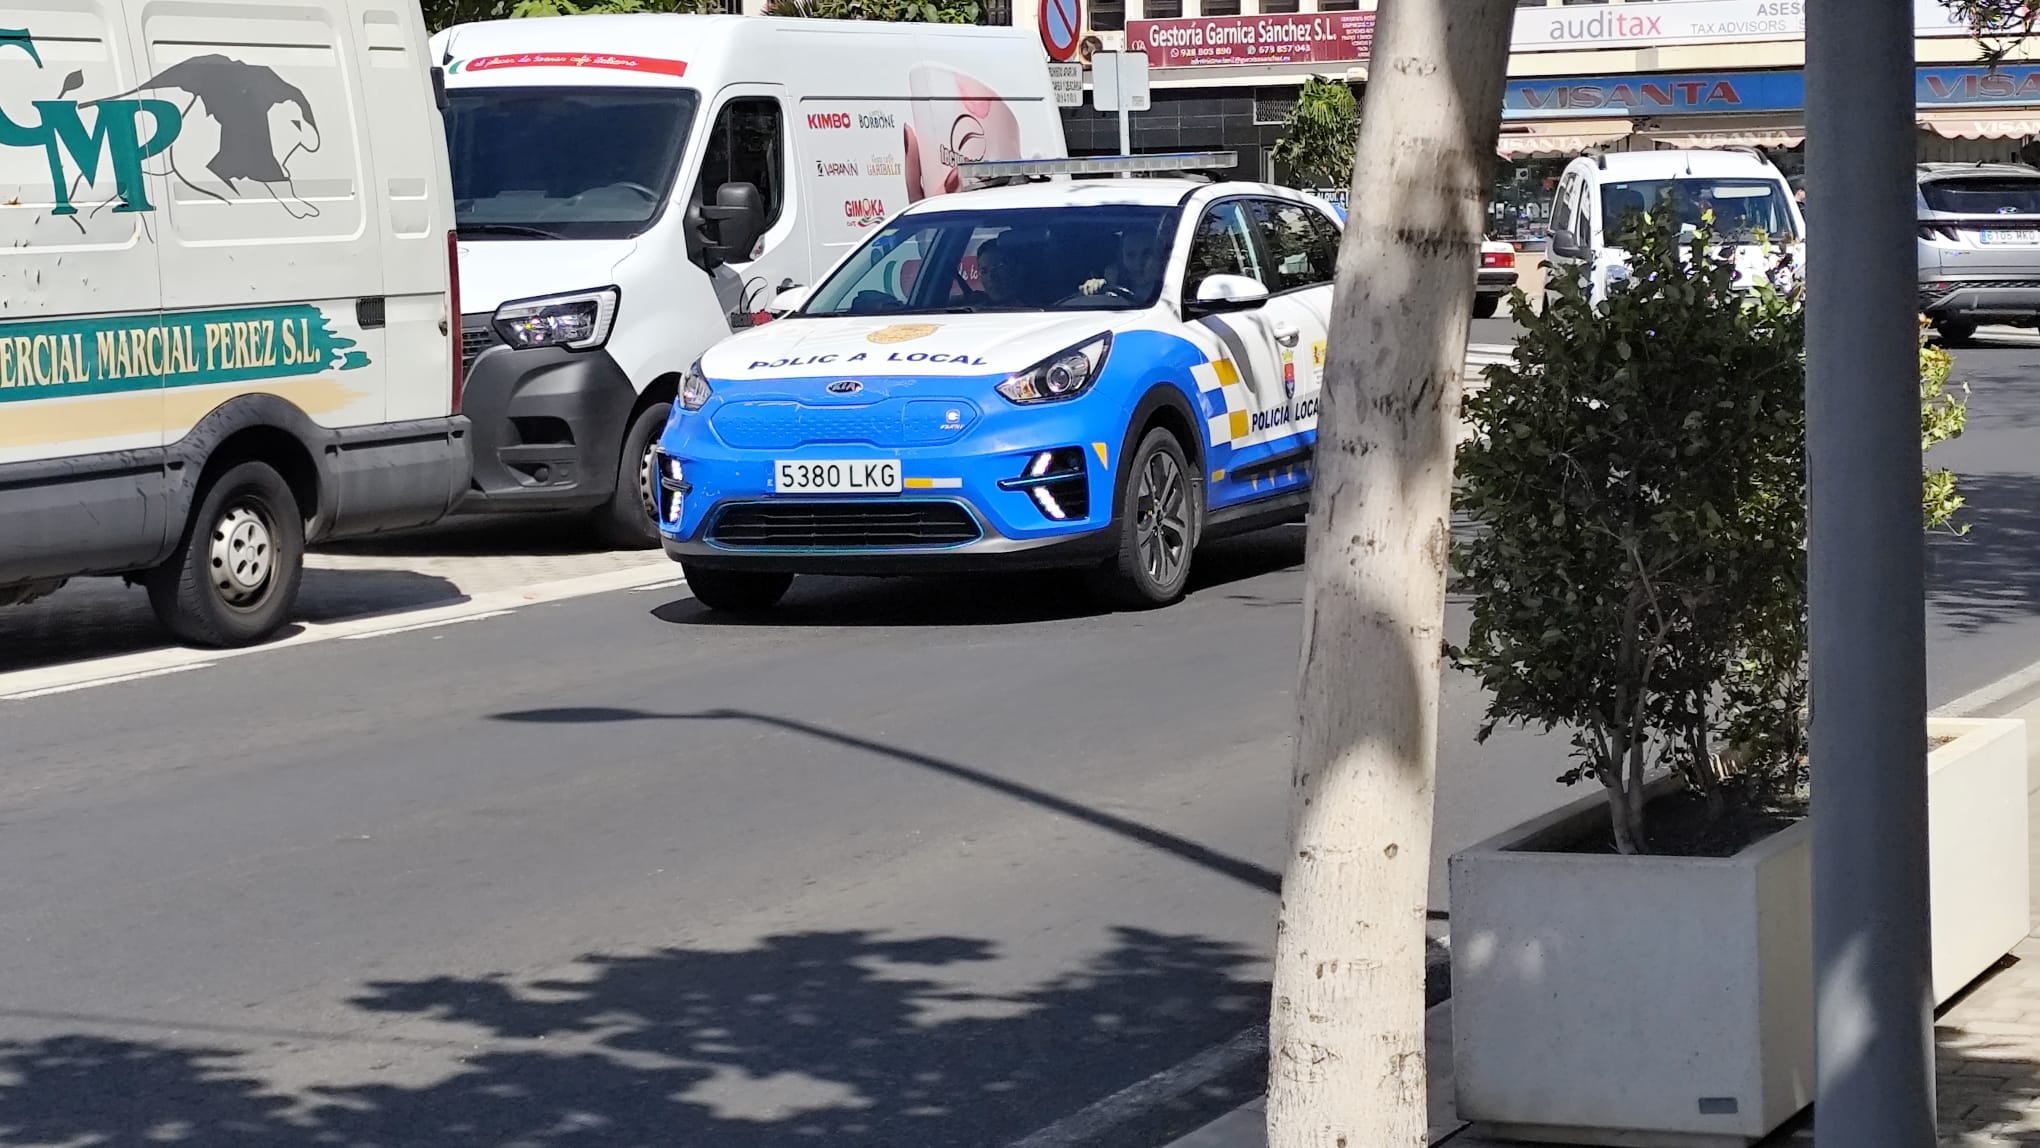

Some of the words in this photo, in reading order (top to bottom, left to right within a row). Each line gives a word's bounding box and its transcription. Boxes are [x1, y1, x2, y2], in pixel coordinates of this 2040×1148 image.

[1757, 2, 1805, 17] ASES
[1149, 22, 1202, 47] Gestoría
[1206, 21, 1255, 45] Garnica
[1258, 18, 1312, 43] Sánchez
[1314, 18, 1337, 41] S.L.
[1550, 11, 1662, 40] auditax
[1691, 23, 1716, 35] TAX
[1718, 19, 1786, 34] ADVISORS
[1521, 81, 1741, 109] VISANTA
[808, 113, 851, 129] KIMBO
[858, 113, 895, 128] BORBONE
[1499, 137, 1583, 151] ISANTA
[1687, 130, 1792, 146] VISANTA
[845, 199, 885, 218] GIMOKA
[96, 325, 199, 380] MARCIAL
[204, 320, 276, 371] PEREZ
[282, 318, 321, 365] S.L.
[888, 352, 987, 366] LOCAL
[1252, 406, 1290, 432] POLICIA
[782, 464, 840, 488] 5380
[849, 463, 895, 488] LKG
